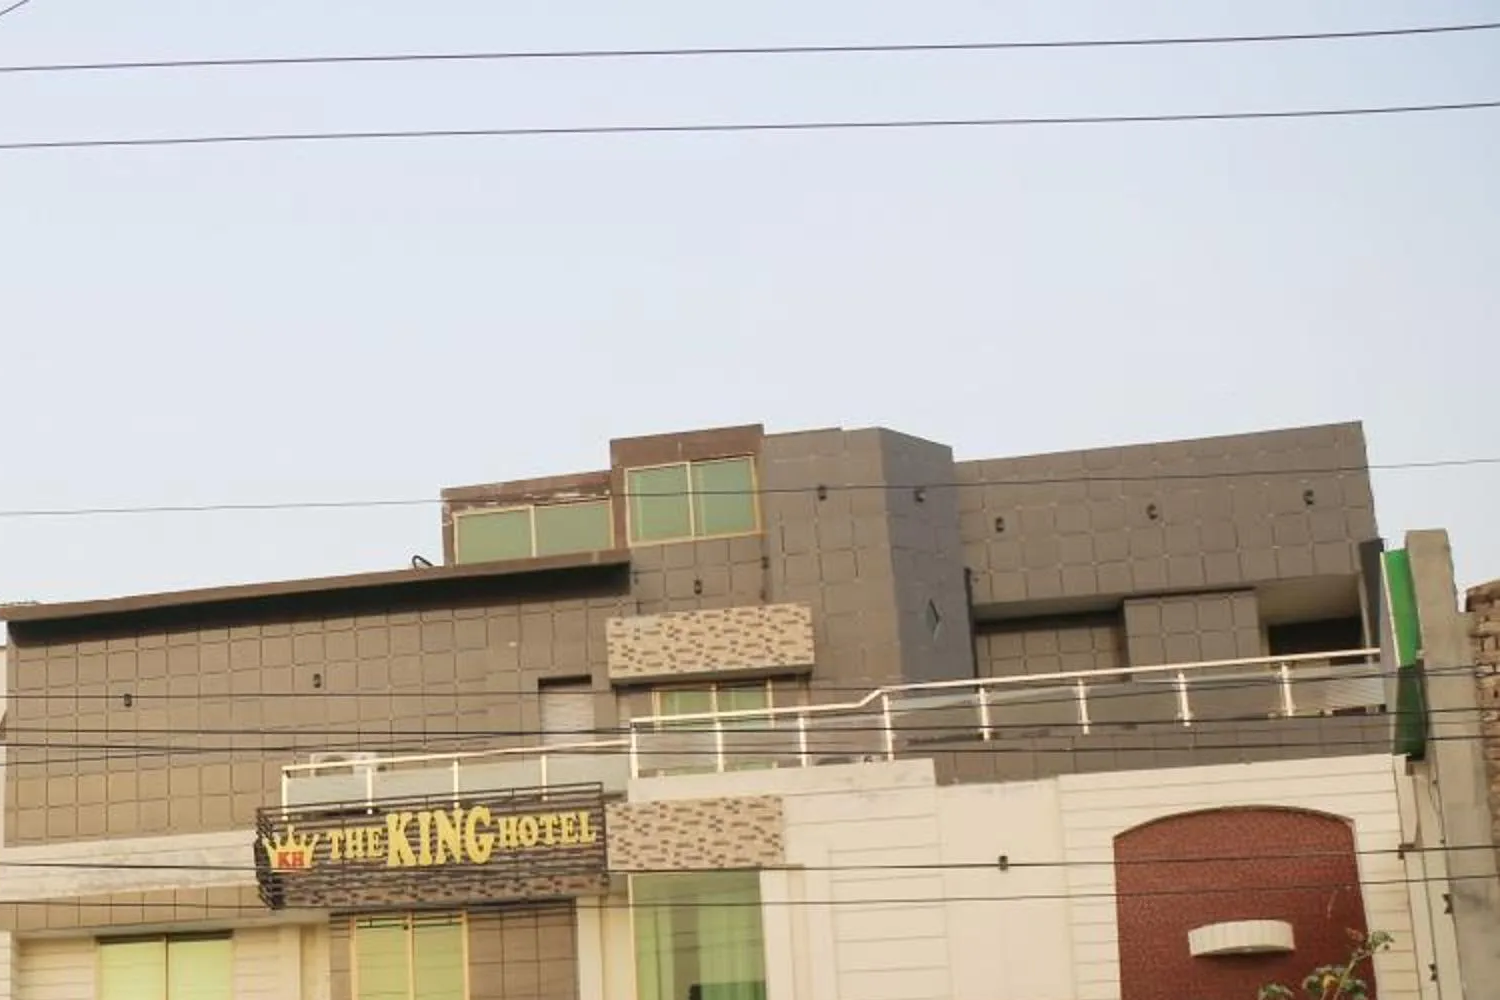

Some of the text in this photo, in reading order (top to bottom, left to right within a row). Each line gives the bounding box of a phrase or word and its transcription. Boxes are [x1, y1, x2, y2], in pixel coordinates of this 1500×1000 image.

[329, 806, 597, 867] THE KING HOTEL
[277, 850, 305, 867] KH
